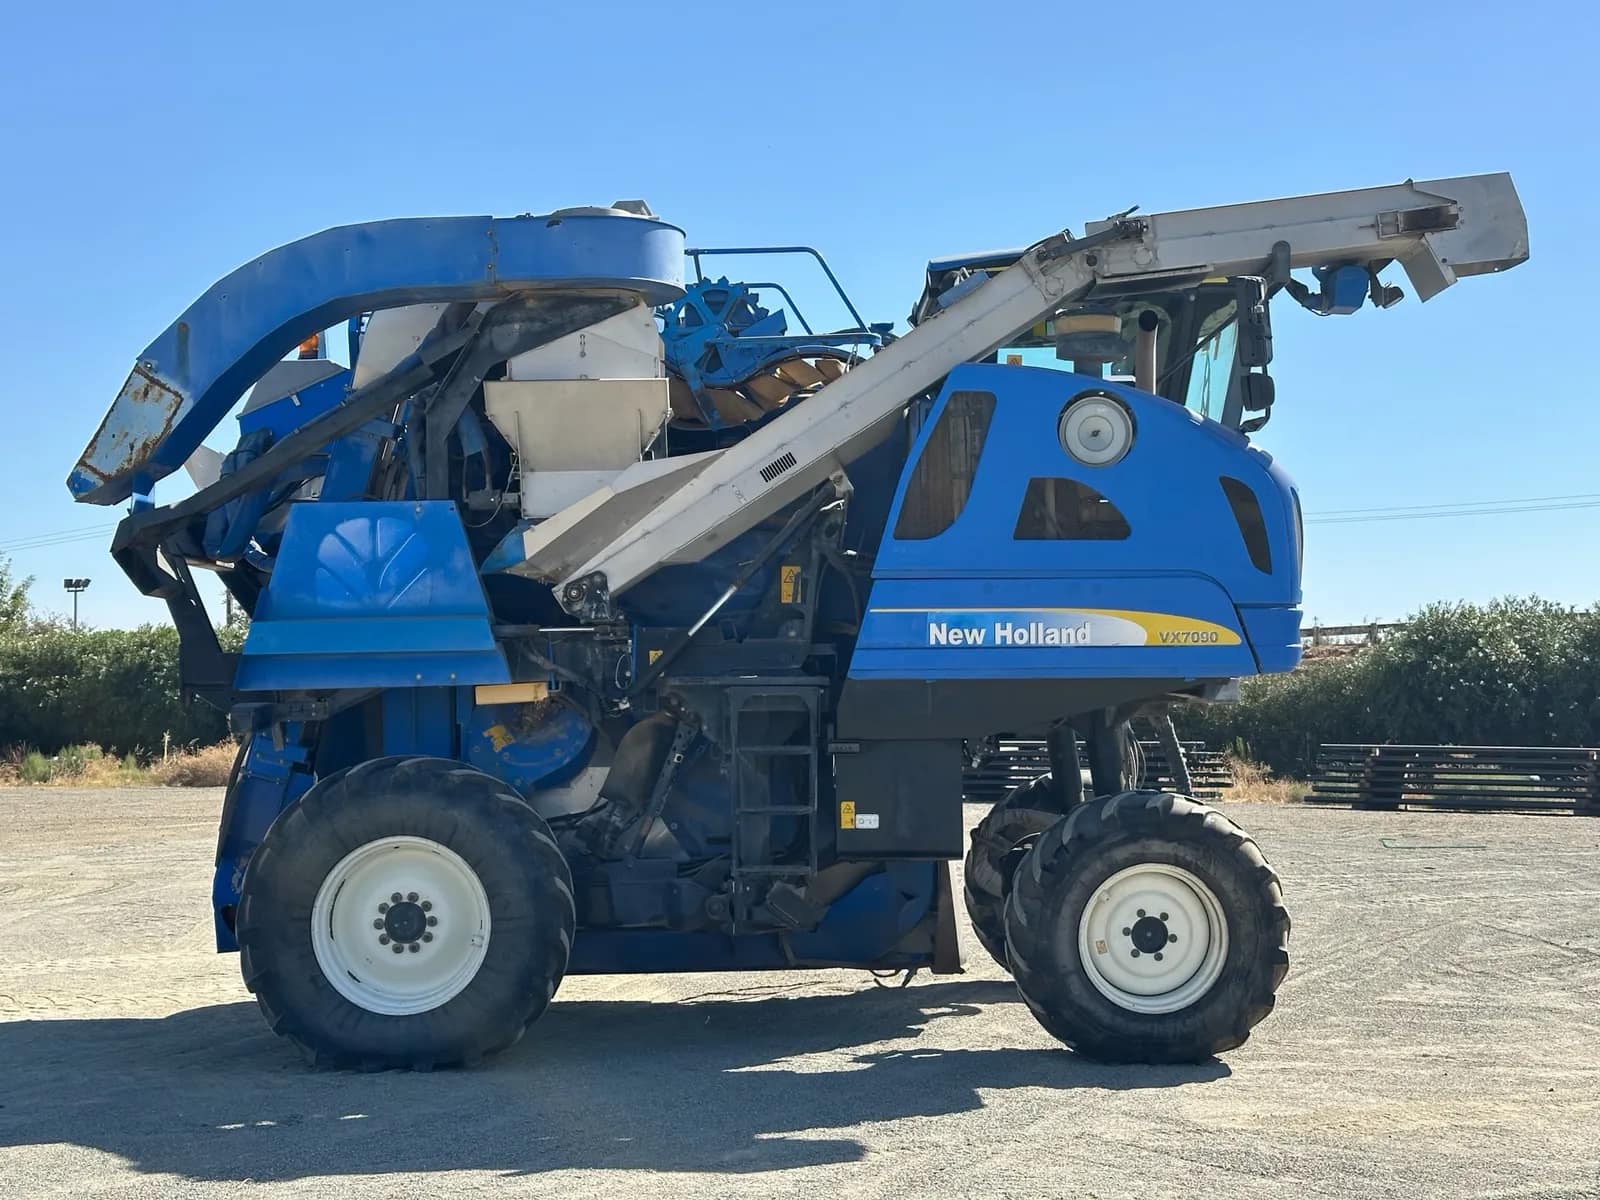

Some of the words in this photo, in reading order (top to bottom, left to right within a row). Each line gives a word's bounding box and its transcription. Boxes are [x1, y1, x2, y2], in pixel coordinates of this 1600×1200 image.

[929, 623, 986, 645] New
[994, 622, 1090, 645] Holland
[1159, 631, 1219, 644] VX7090
